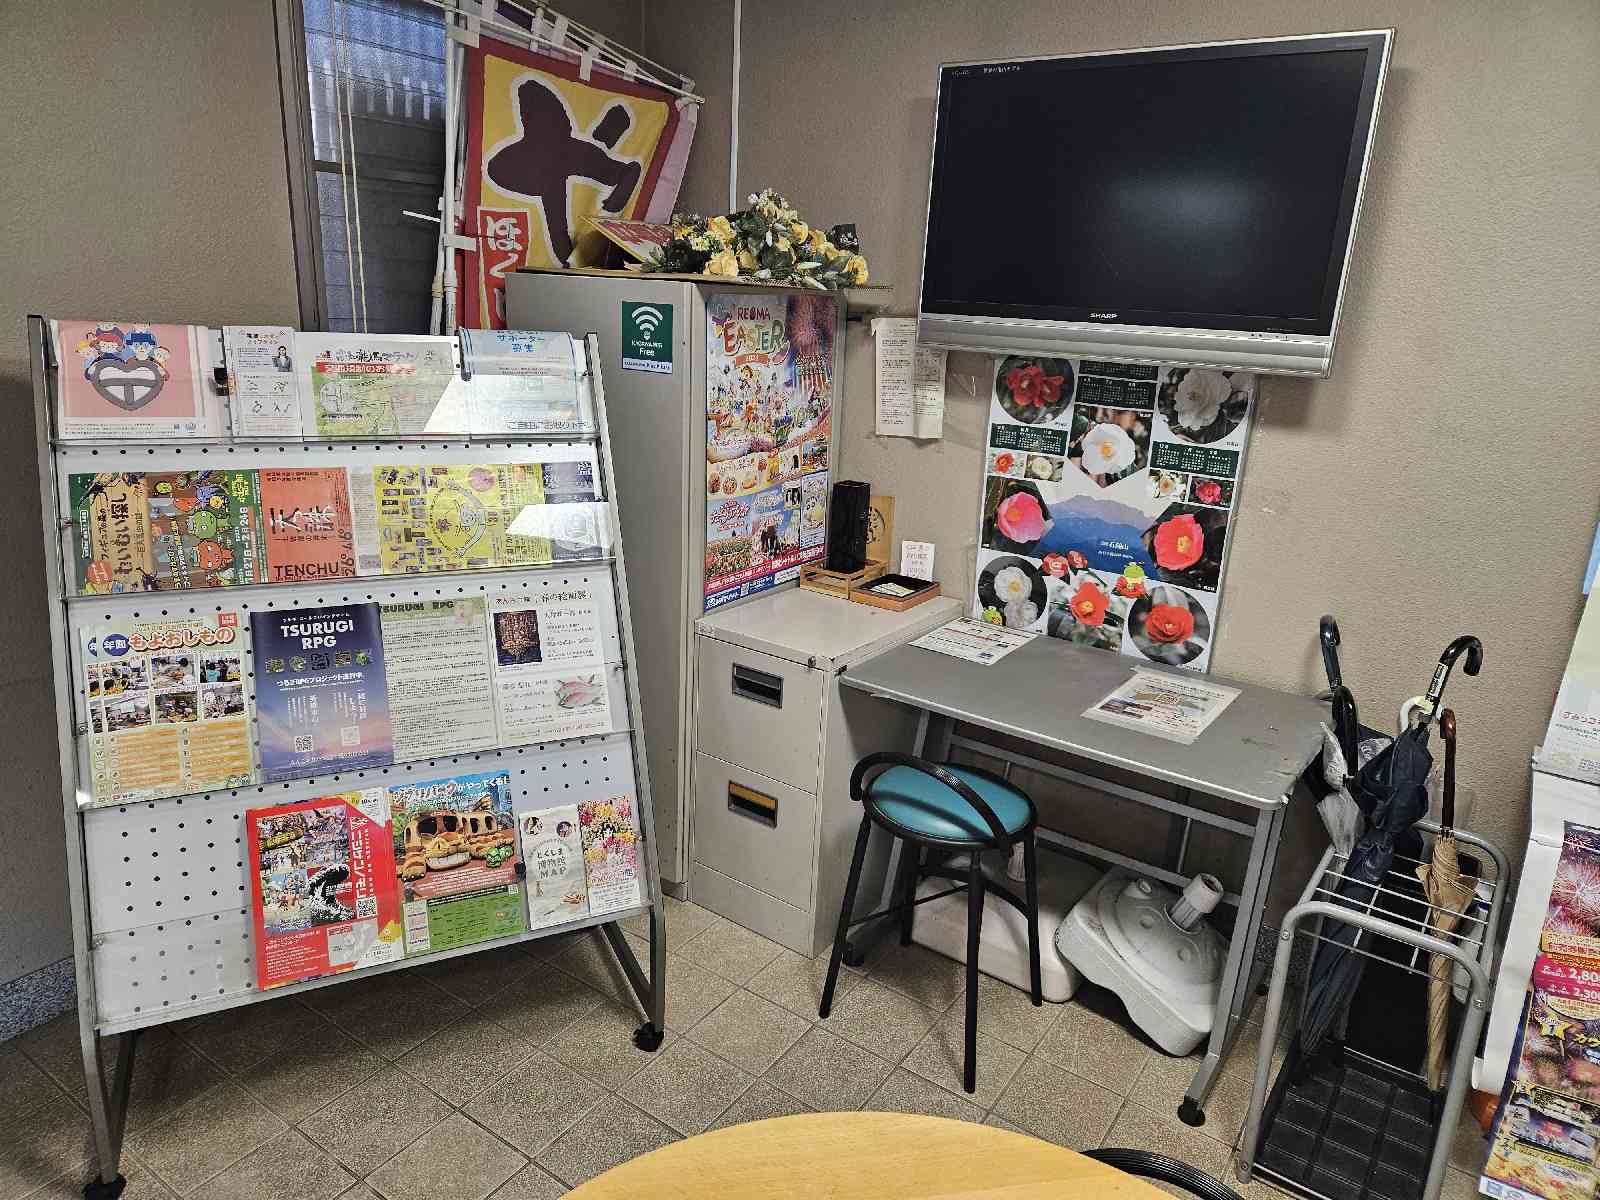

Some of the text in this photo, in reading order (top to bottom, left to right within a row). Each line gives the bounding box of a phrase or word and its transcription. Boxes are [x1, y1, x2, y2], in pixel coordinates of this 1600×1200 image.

[1090, 312, 1118, 320] SHARP
[639, 348, 655, 357] Free
[273, 561, 339, 579] TENCHU
[432, 601, 454, 610] RPG
[280, 619, 355, 638] TSURUGI
[128, 625, 236, 652] もよおしもの
[302, 635, 337, 650] RPG
